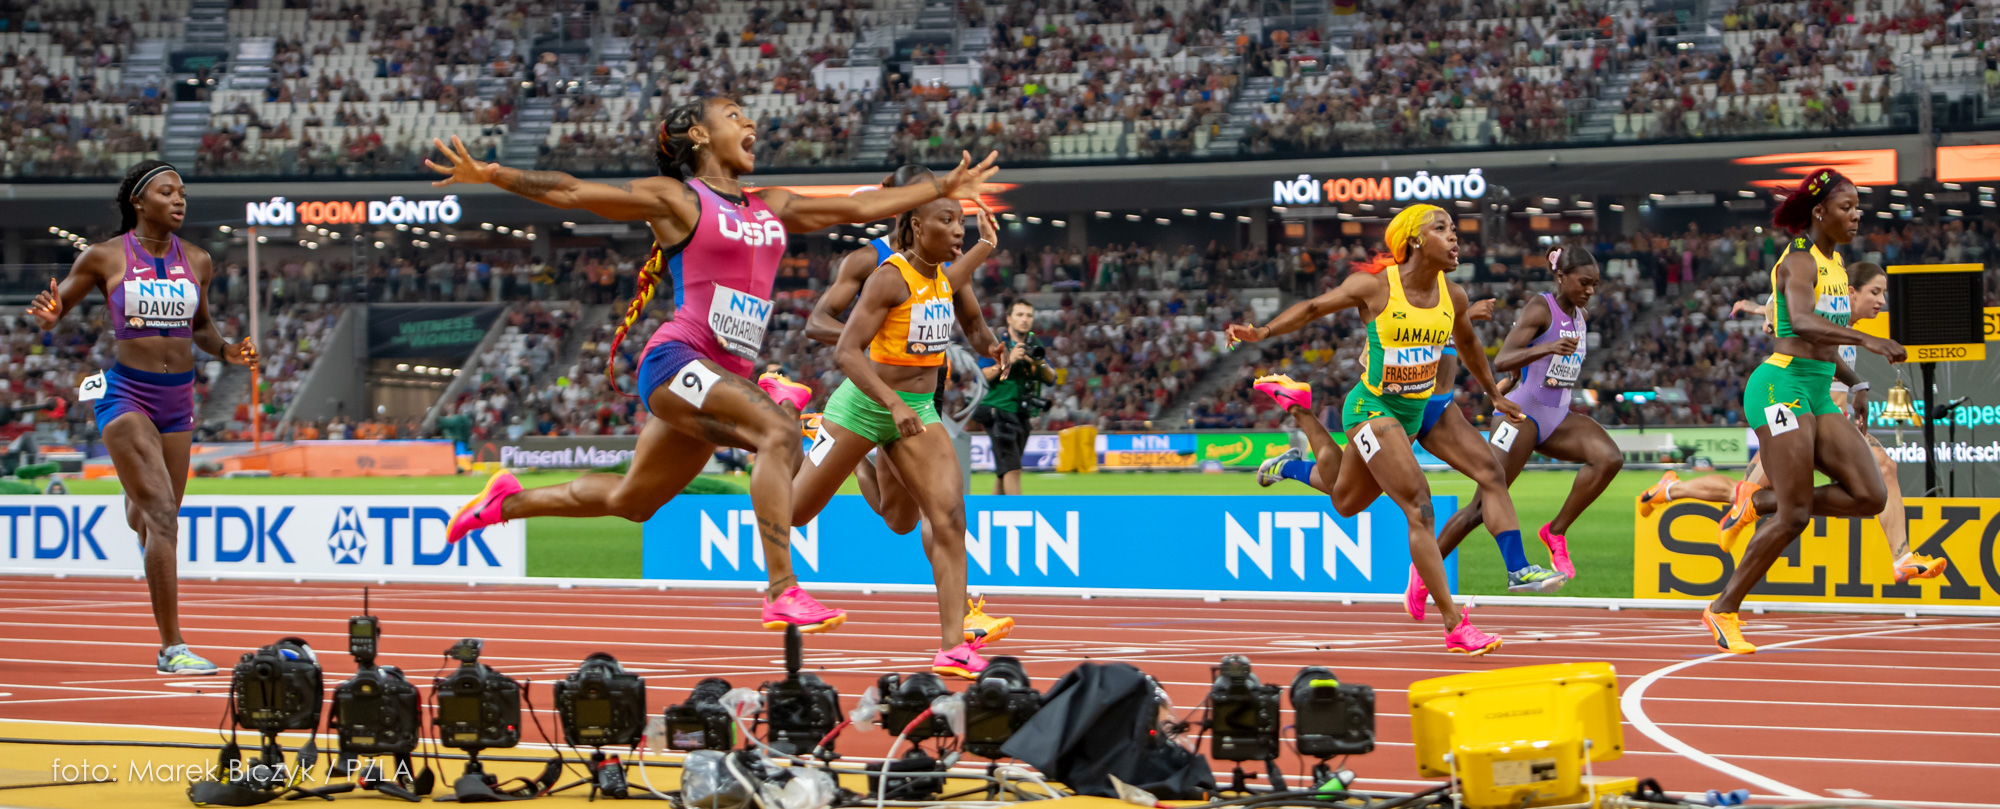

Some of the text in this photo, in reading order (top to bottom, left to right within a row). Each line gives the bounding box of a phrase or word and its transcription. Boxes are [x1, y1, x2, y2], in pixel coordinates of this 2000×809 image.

[1273, 168, 1486, 204] NŐI 100M DÖNTŐ
[246, 195, 462, 225] NŐI 100M DÖNTŐ
[718, 213, 786, 247] USA
[139, 282, 184, 298] NTN
[138, 300, 185, 316] DAVIS
[730, 291, 770, 322] NTN
[924, 303, 951, 321] NTN
[399, 316, 475, 334] WITNESS
[918, 324, 933, 340] TA
[1397, 346, 1434, 364] NTN
[1918, 346, 1967, 359] SEIKO
[681, 371, 702, 393] 9
[1775, 408, 1788, 427] 4
[811, 432, 827, 452] 7
[1132, 435, 1170, 449] NTN
[1360, 433, 1371, 454] 5
[1497, 426, 1509, 445] 2
[500, 445, 573, 467] Pinsent
[0, 506, 108, 560] TDK
[178, 506, 296, 564] TDK
[368, 506, 502, 567] TDK
[700, 509, 819, 573] NTN
[965, 510, 1080, 577] NTN
[1225, 510, 1372, 581] NTN
